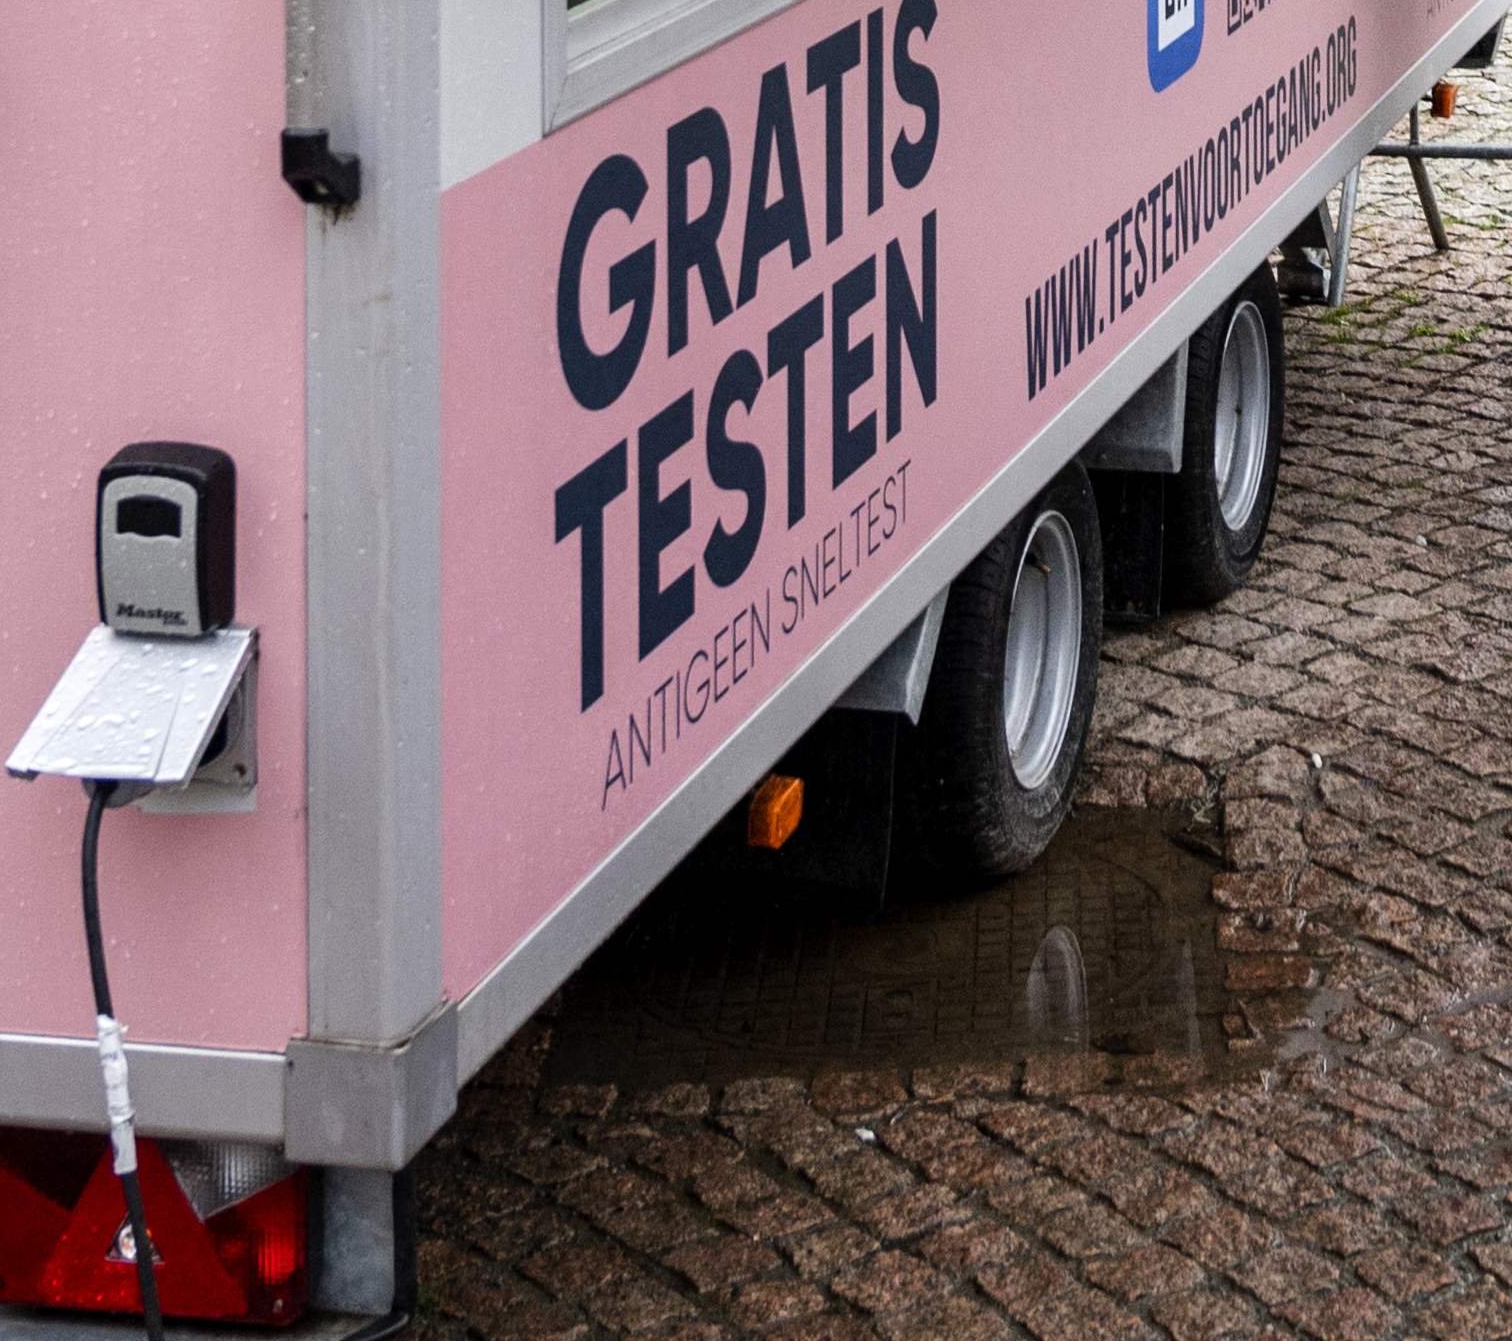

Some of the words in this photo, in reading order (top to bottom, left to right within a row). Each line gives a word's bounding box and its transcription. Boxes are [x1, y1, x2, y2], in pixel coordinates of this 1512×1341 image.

[1024, 15, 1359, 403] WWW.TESTENVOORTOEGANG.ORG
[116, 602, 185, 620] Master
[553, 208, 939, 715] TESTEN
[600, 599, 771, 813] ANTIGEEN
[780, 460, 912, 638] SNELTEST
